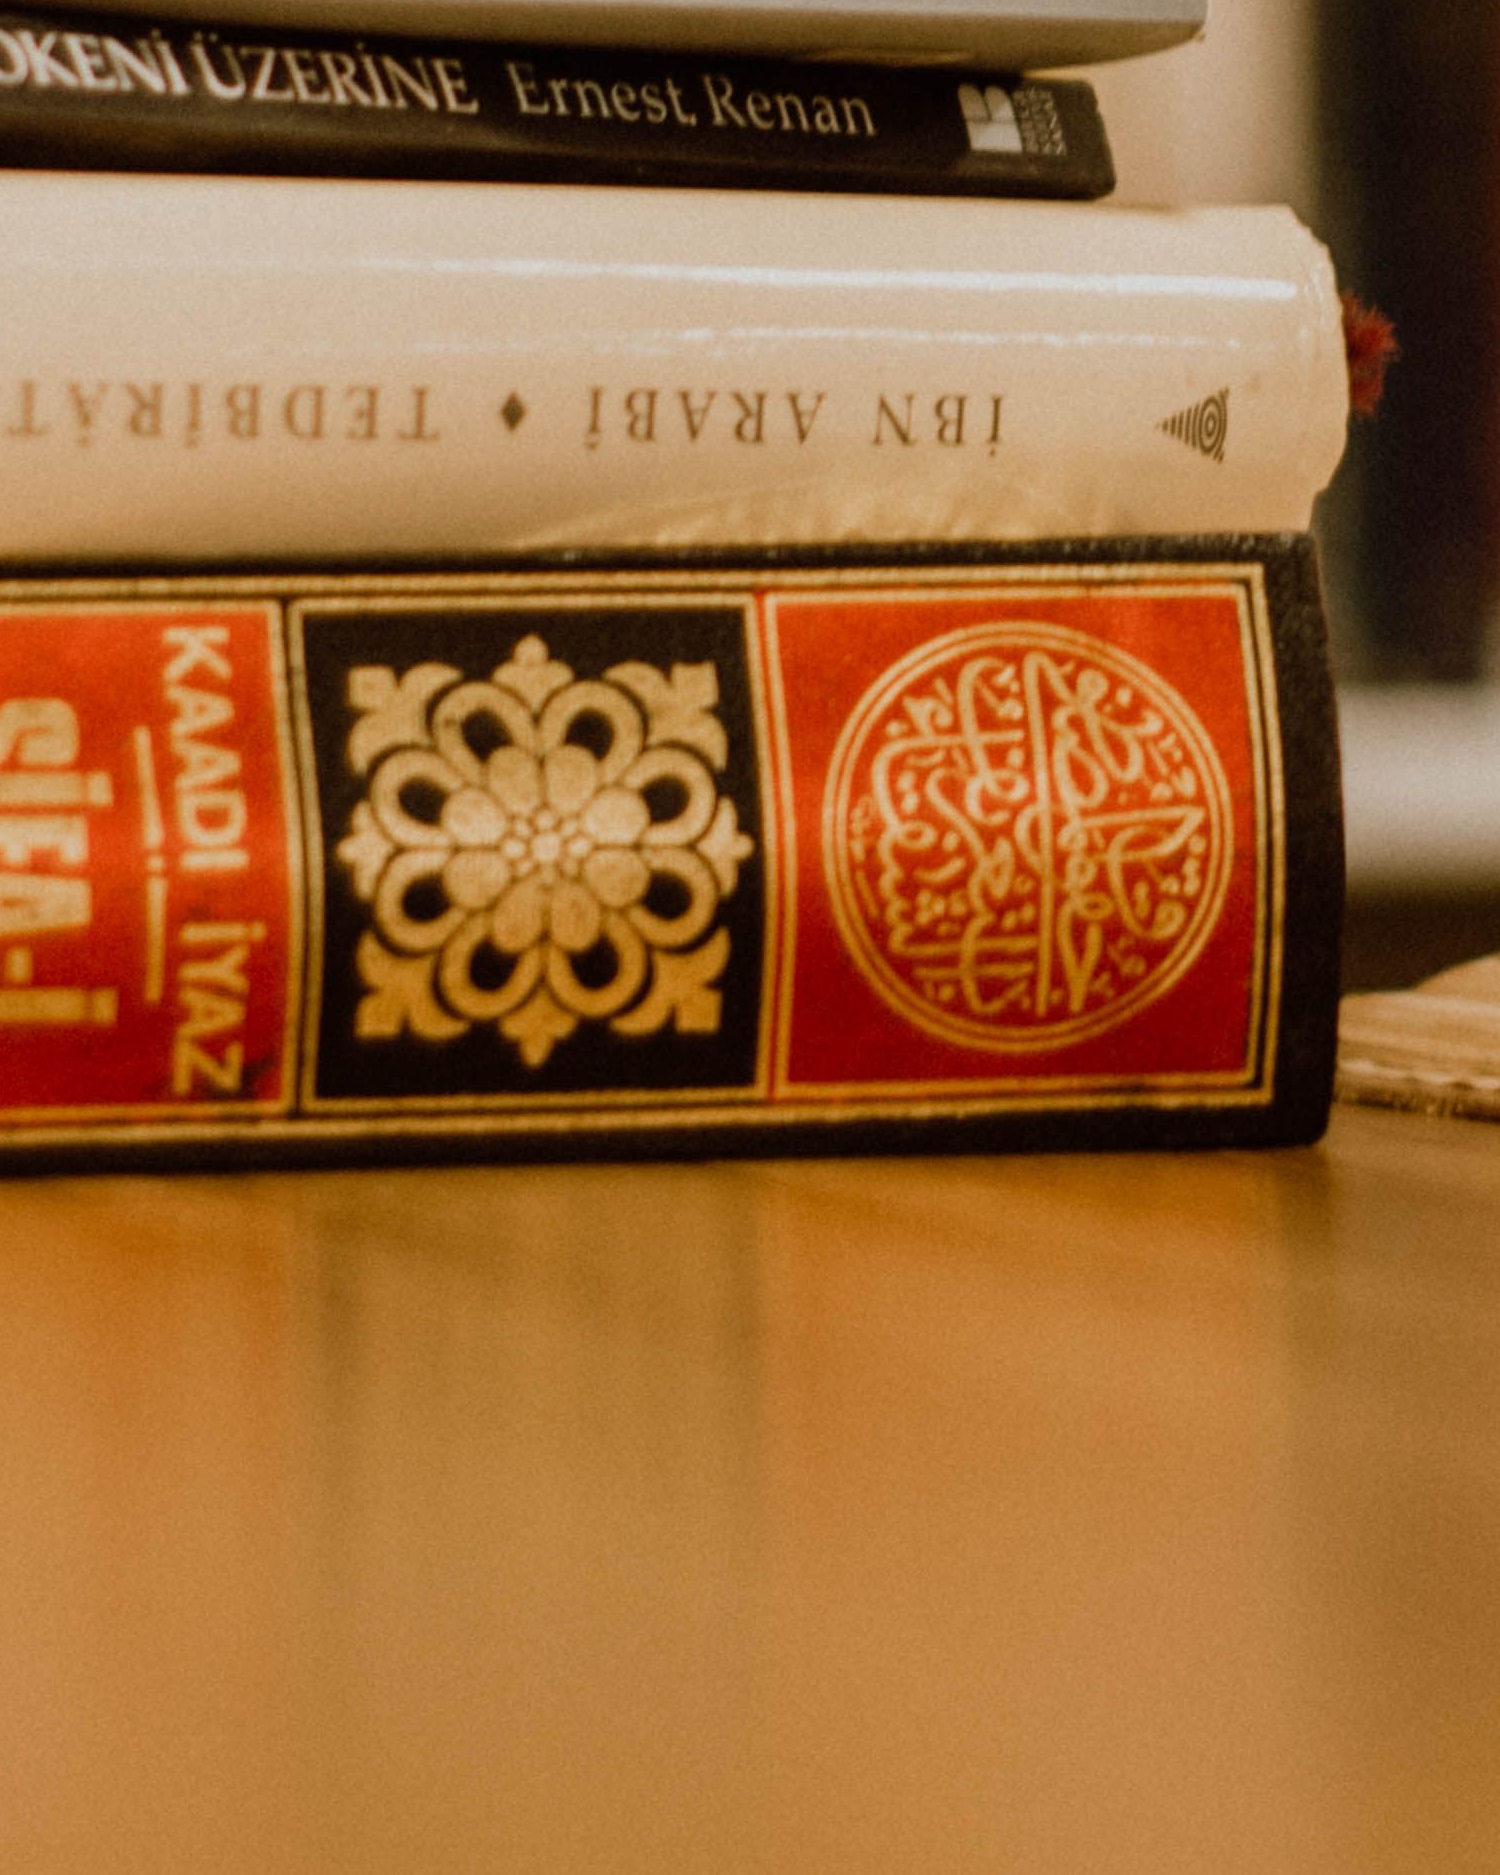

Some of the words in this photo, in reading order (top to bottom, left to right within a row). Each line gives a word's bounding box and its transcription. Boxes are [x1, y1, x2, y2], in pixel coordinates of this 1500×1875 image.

[191, 32, 479, 114] ÜZERİNE
[507, 62, 693, 128] Ernest
[705, 77, 875, 136] Renan
[872, 395, 1002, 457] İBN
[160, 624, 249, 874] KAADI
[173, 919, 267, 1097] İYAZ
